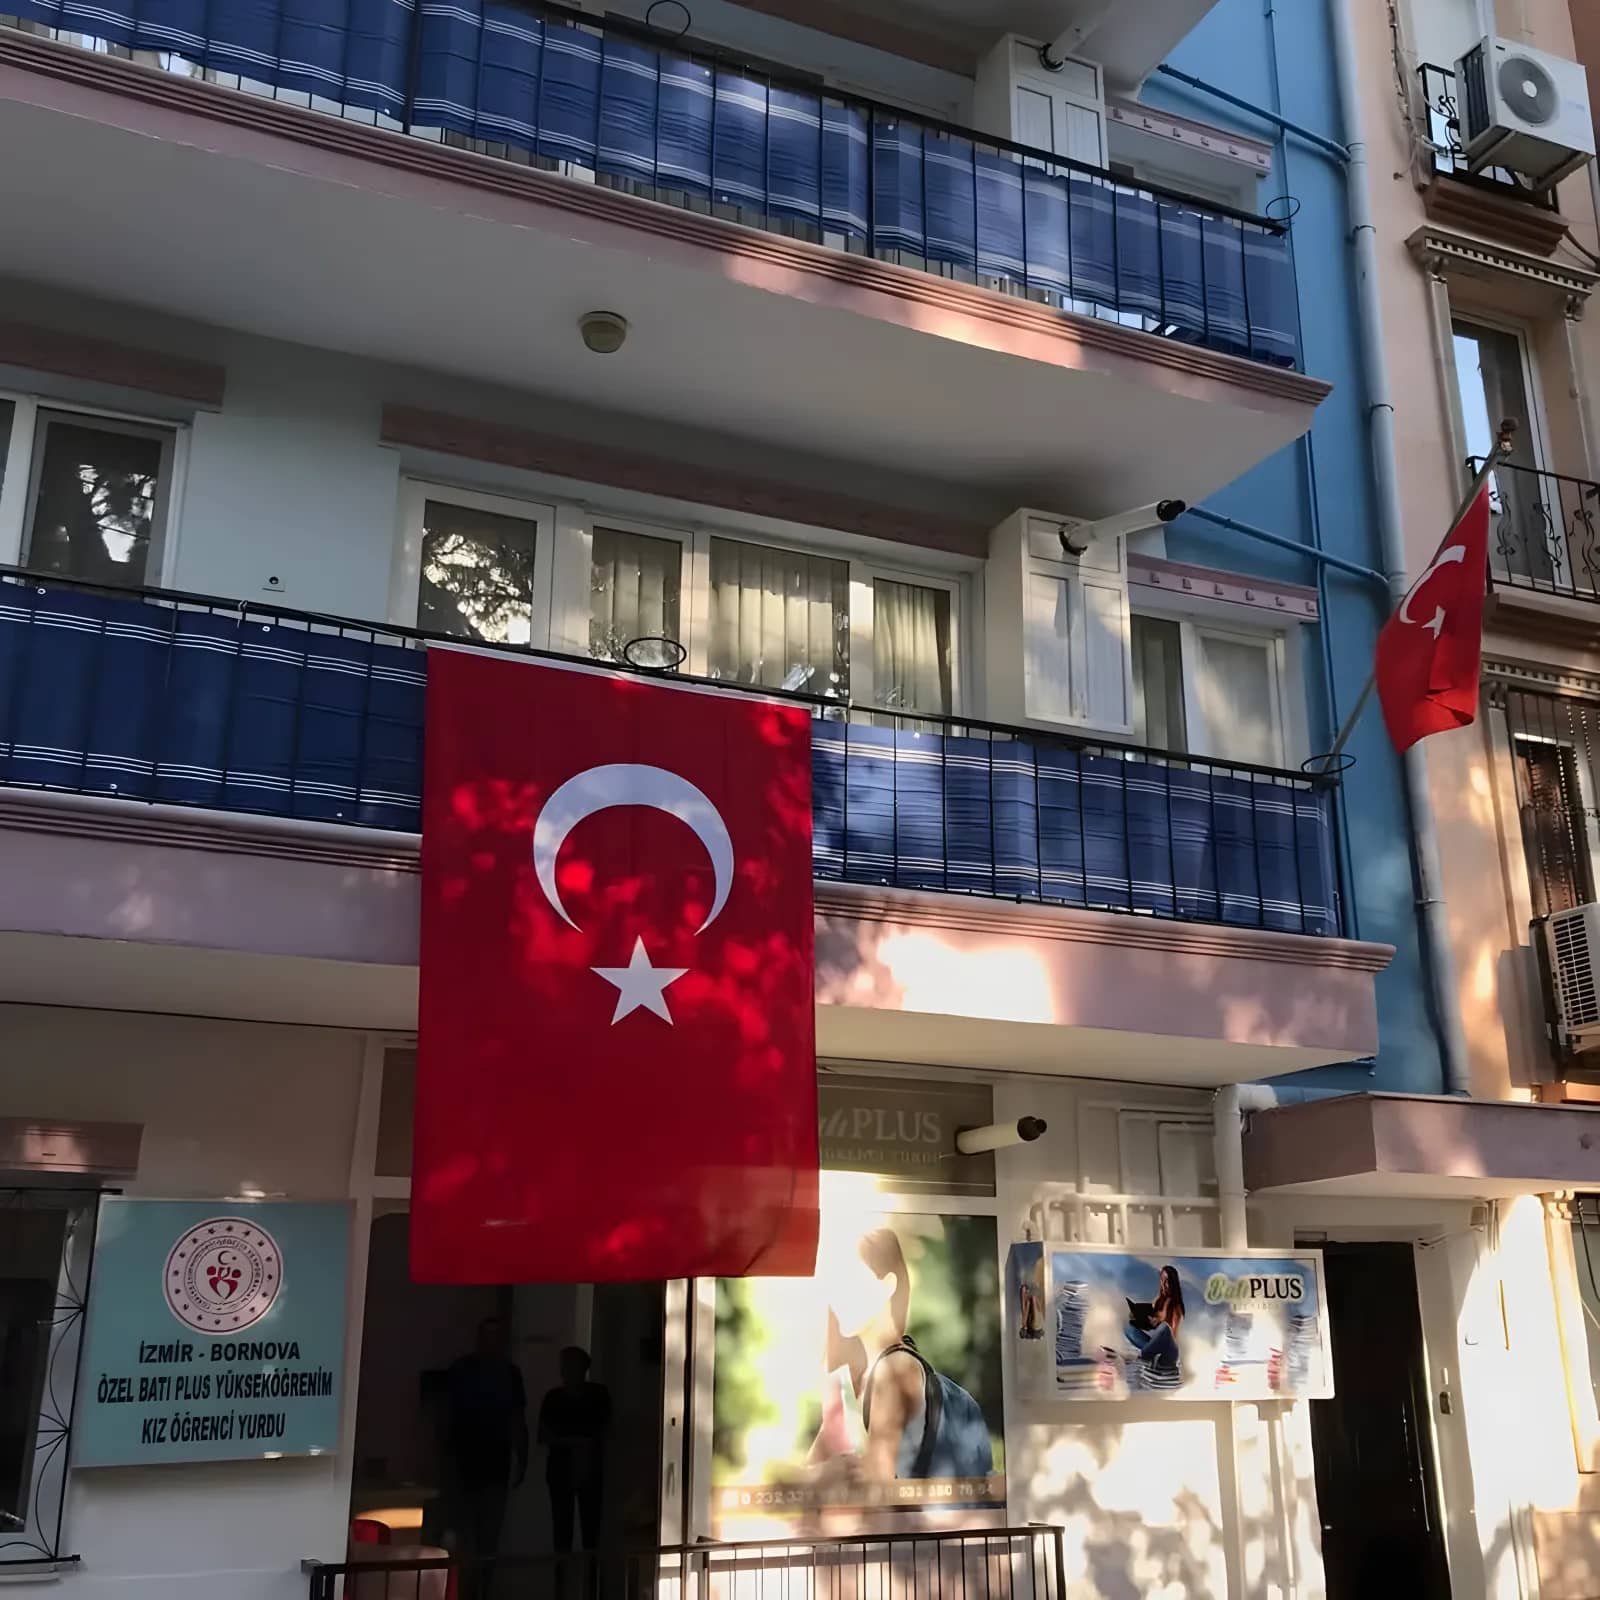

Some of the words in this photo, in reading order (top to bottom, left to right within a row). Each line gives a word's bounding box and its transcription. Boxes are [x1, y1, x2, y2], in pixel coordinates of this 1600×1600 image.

[138, 1339, 193, 1363] İZMİR
[210, 1341, 300, 1362] BORNOVA
[97, 1373, 134, 1403] ÖZEL
[138, 1376, 171, 1402] BATI
[175, 1374, 211, 1401] PLUS
[215, 1366, 333, 1399] YÜKSEKÖĞRENİM
[141, 1417, 167, 1444] KIZ
[170, 1409, 234, 1442] ÖĞRENCİ
[238, 1412, 286, 1440] YURDU
